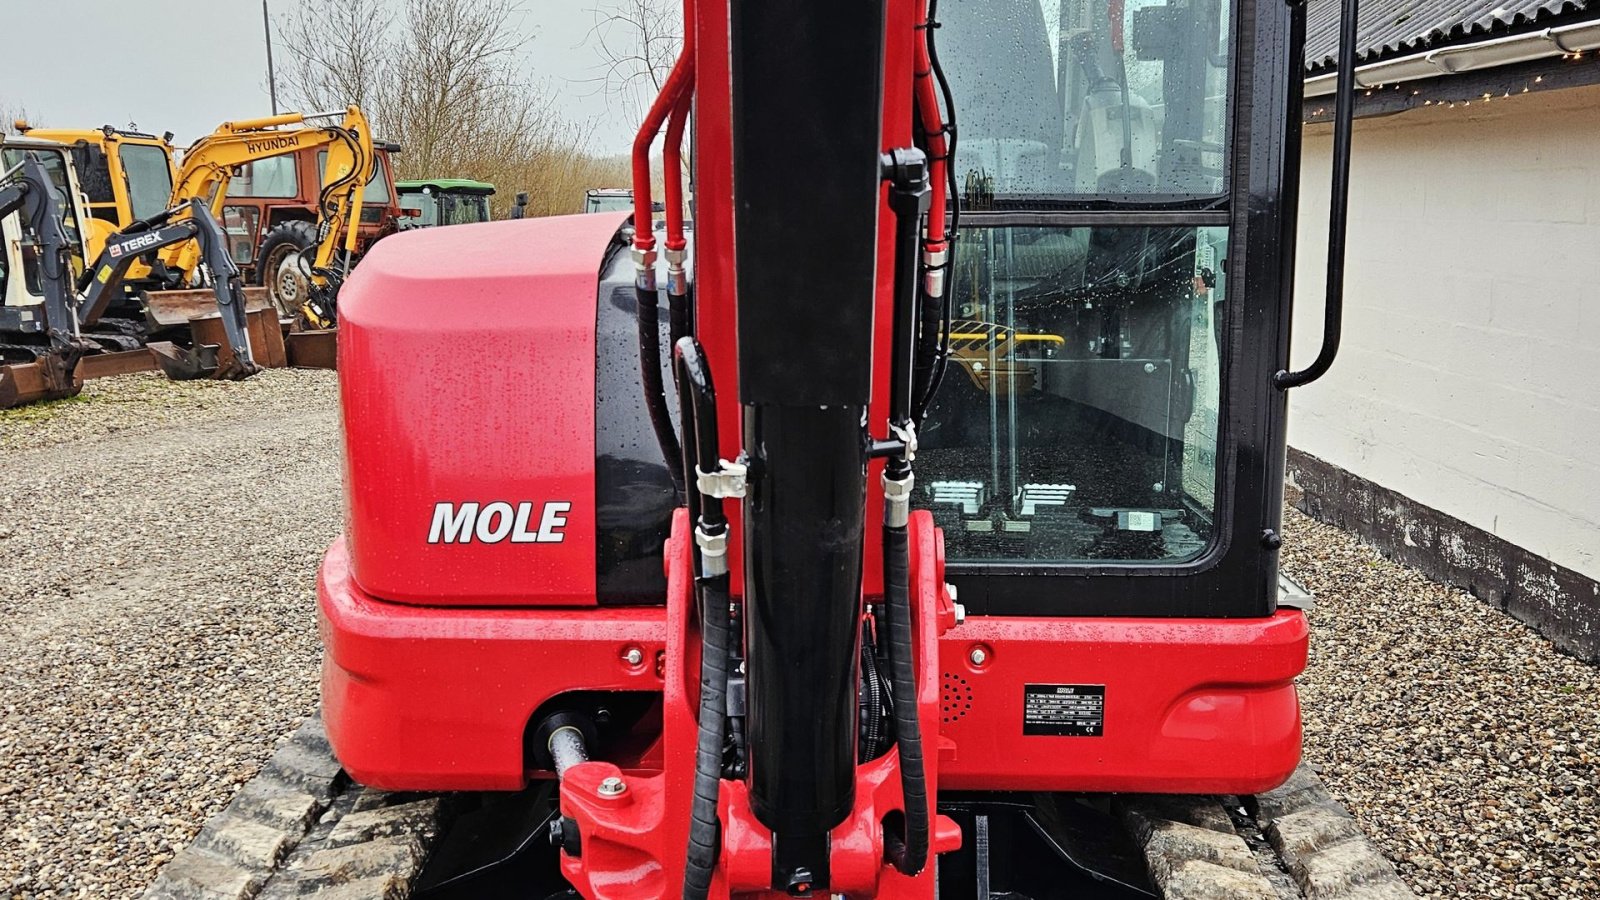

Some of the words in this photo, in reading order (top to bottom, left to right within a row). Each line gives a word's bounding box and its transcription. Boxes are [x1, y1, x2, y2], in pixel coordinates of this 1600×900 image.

[248, 135, 300, 154] HYUNDAI
[121, 231, 163, 252] TEREX
[427, 501, 572, 544] MOLE
